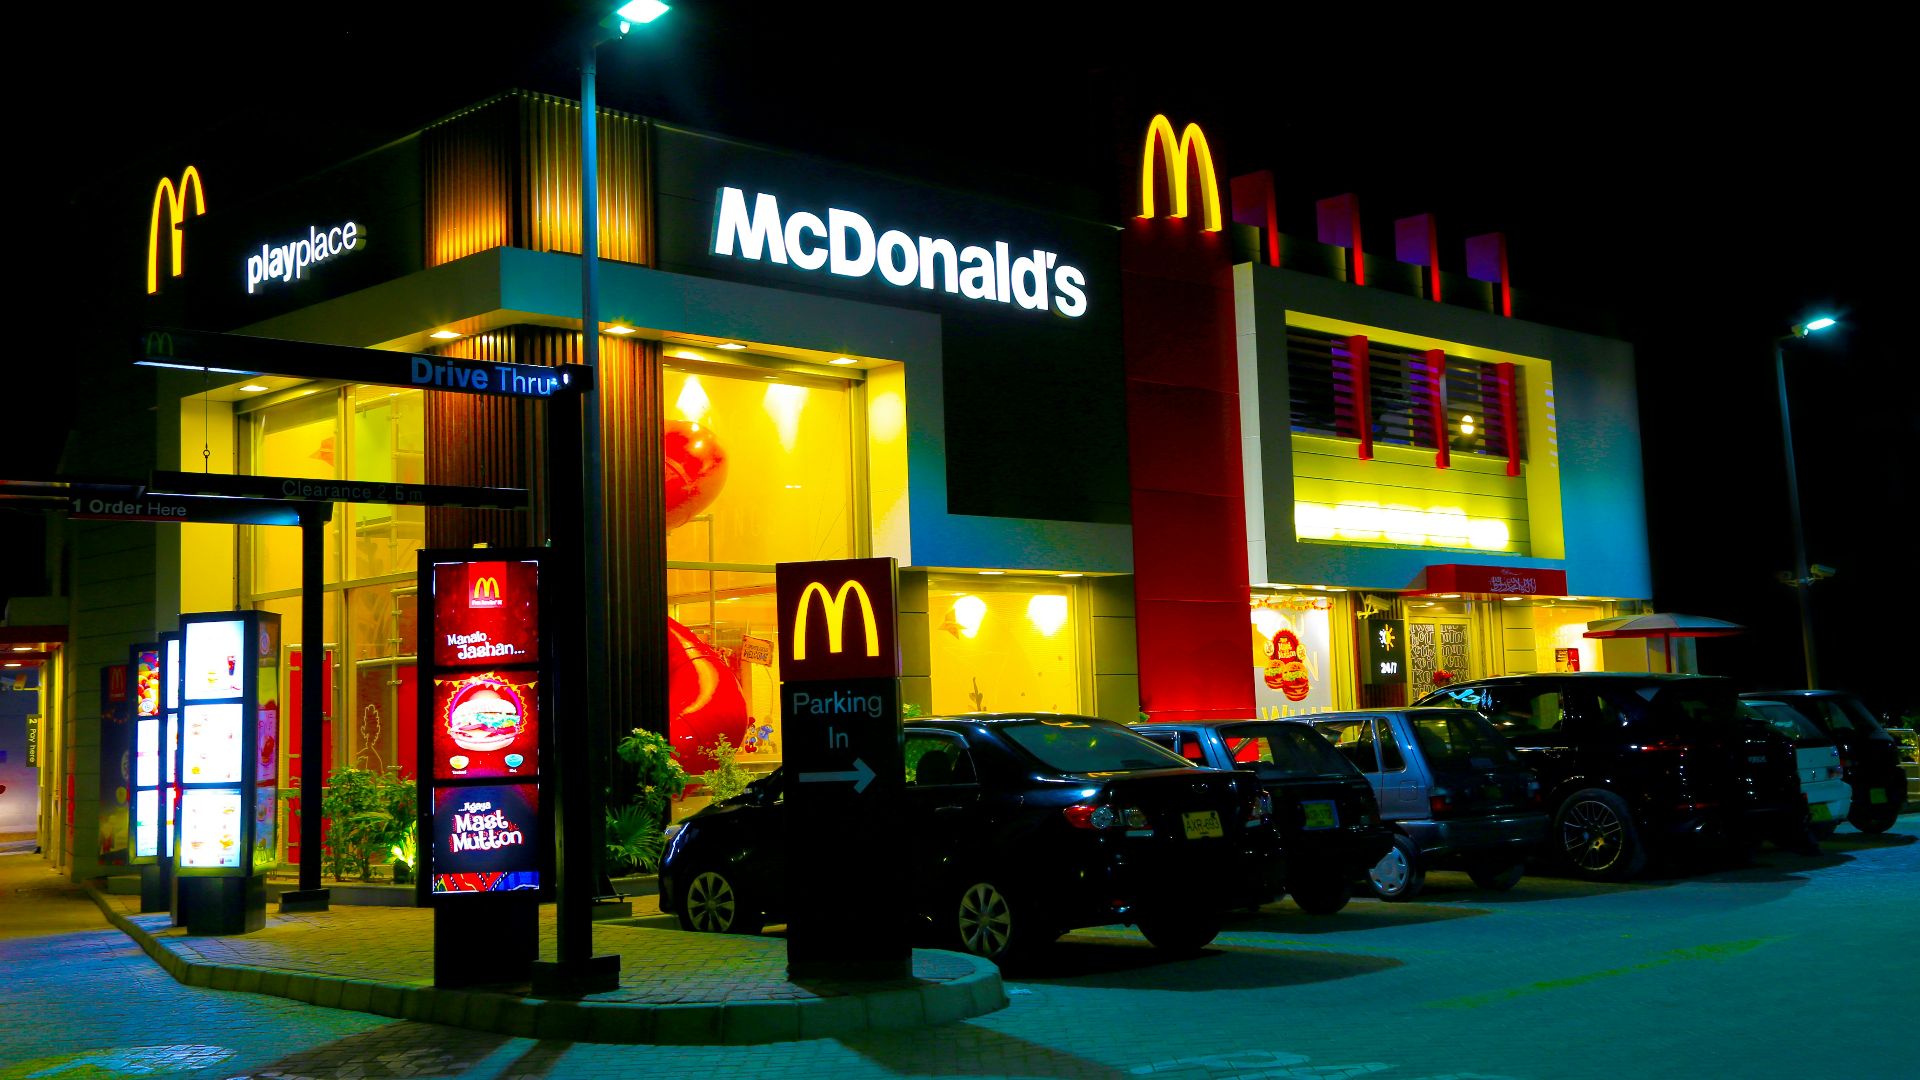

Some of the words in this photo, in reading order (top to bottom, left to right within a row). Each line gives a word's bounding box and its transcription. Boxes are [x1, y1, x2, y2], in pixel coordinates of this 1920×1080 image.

[247, 220, 359, 294] playplace
[714, 186, 1088, 318] McDonald's
[410, 356, 489, 390] Drive
[495, 365, 552, 395] Thru
[281, 479, 371, 499] Clearance
[71, 498, 82, 513] 1
[88, 498, 144, 515] Order
[147, 502, 188, 517] Here
[446, 630, 488, 647] Manalo
[456, 641, 526, 661] Jashan...
[1380, 661, 1398, 675] 24/7
[792, 690, 884, 719] Parking
[28, 729, 37, 743] Pay
[827, 726, 850, 751] In
[454, 809, 509, 834] Mast
[451, 829, 523, 853] Mutton
